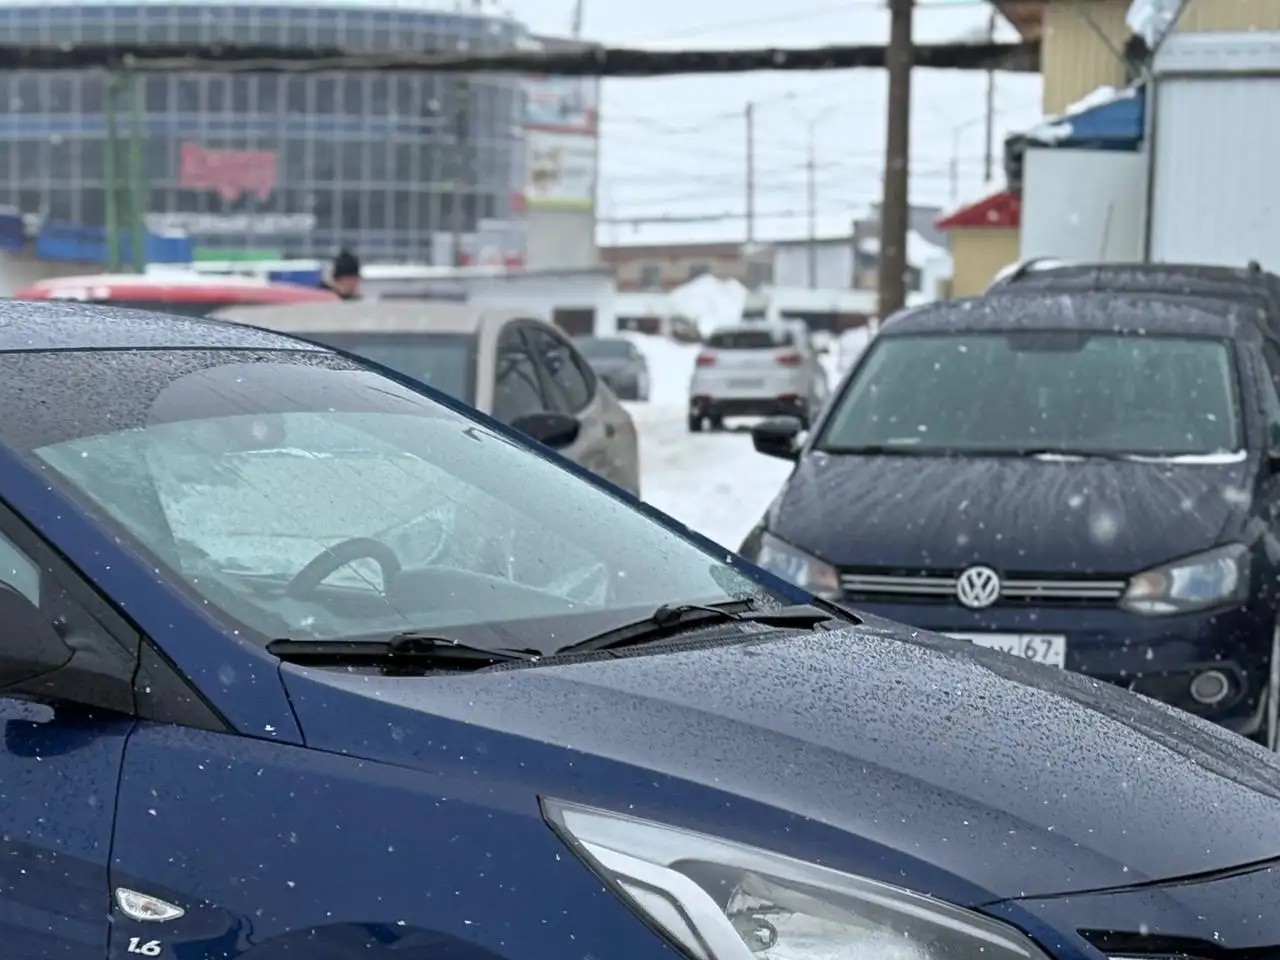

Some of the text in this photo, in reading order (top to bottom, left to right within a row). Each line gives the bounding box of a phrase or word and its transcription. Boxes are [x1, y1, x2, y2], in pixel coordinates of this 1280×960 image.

[958, 566, 999, 607] VW
[1024, 638, 1053, 660] 67
[128, 937, 161, 956] 1.6
